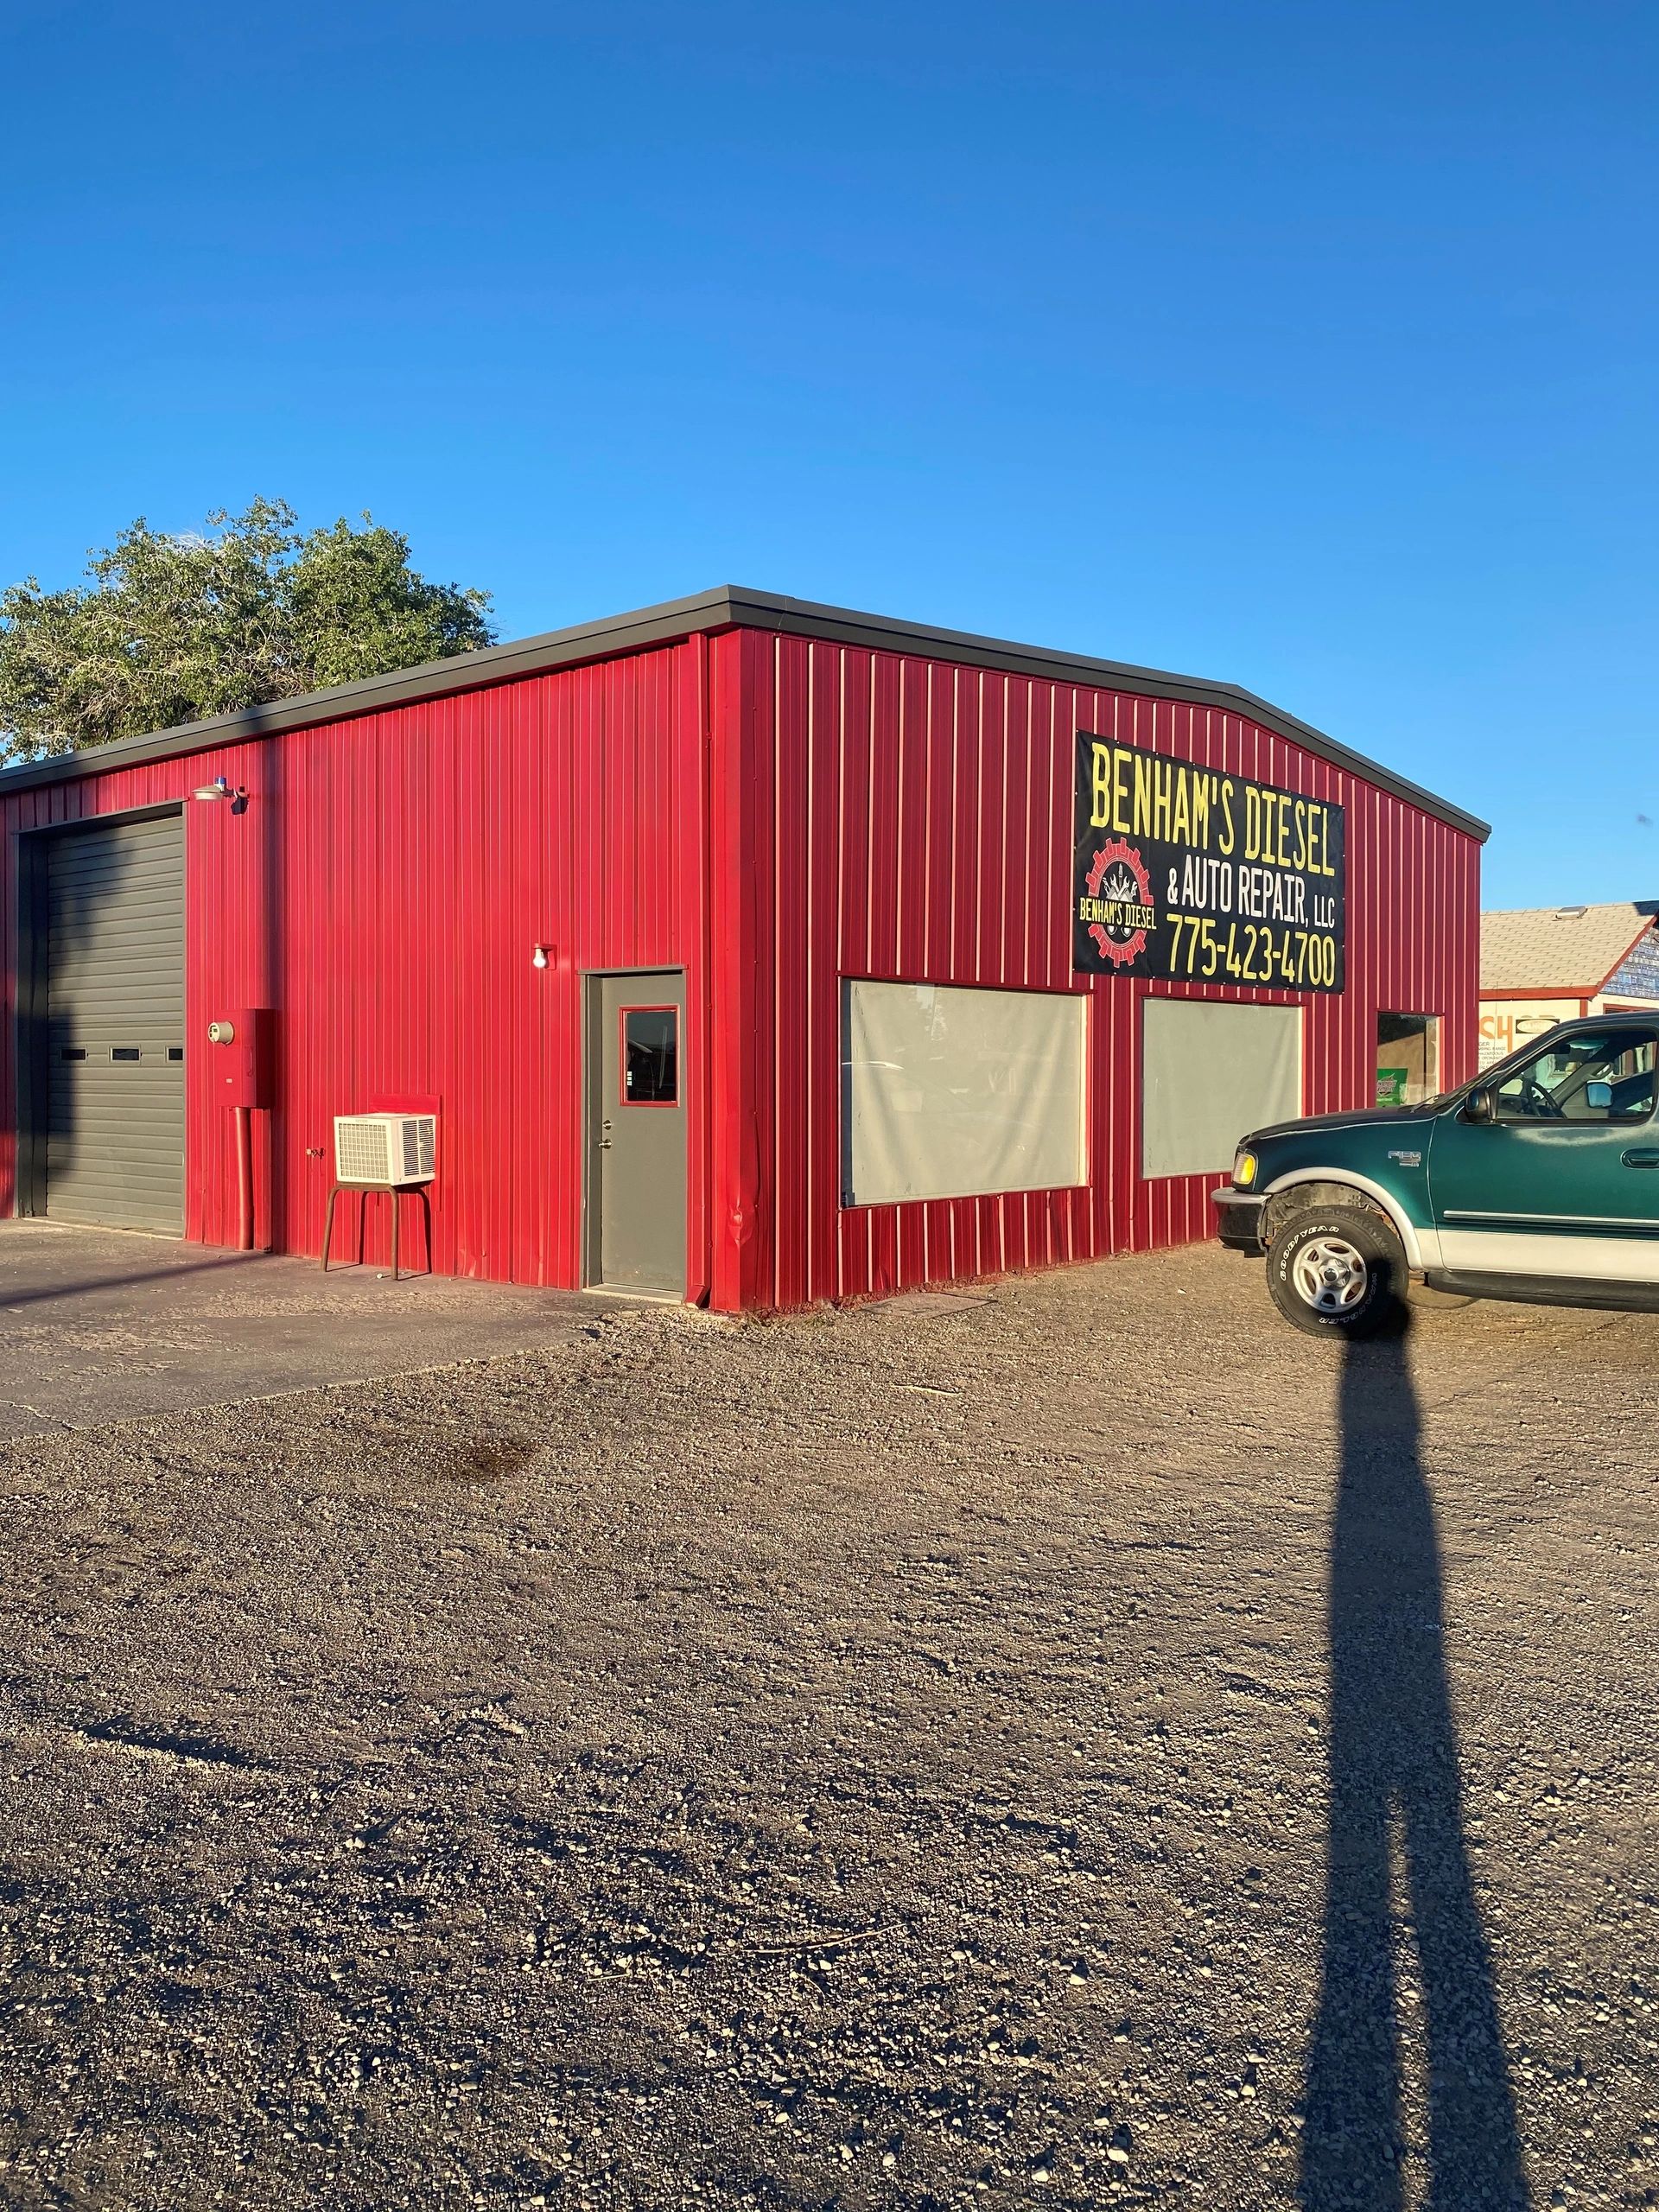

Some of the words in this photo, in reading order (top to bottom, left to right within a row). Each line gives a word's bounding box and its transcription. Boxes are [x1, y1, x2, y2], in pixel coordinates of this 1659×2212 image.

[1090, 741, 1235, 855] BENHAM'S
[1244, 785, 1336, 878] DIESEL
[1079, 897, 1122, 925] BENHAM'S
[1124, 903, 1158, 930] DIESEL
[1166, 867, 1179, 905] &
[1181, 854, 1231, 913] AUTO
[1238, 865, 1309, 928] REPAIR,
[1313, 893, 1336, 928] LLC
[1166, 913, 1336, 987] 775-423-4700
